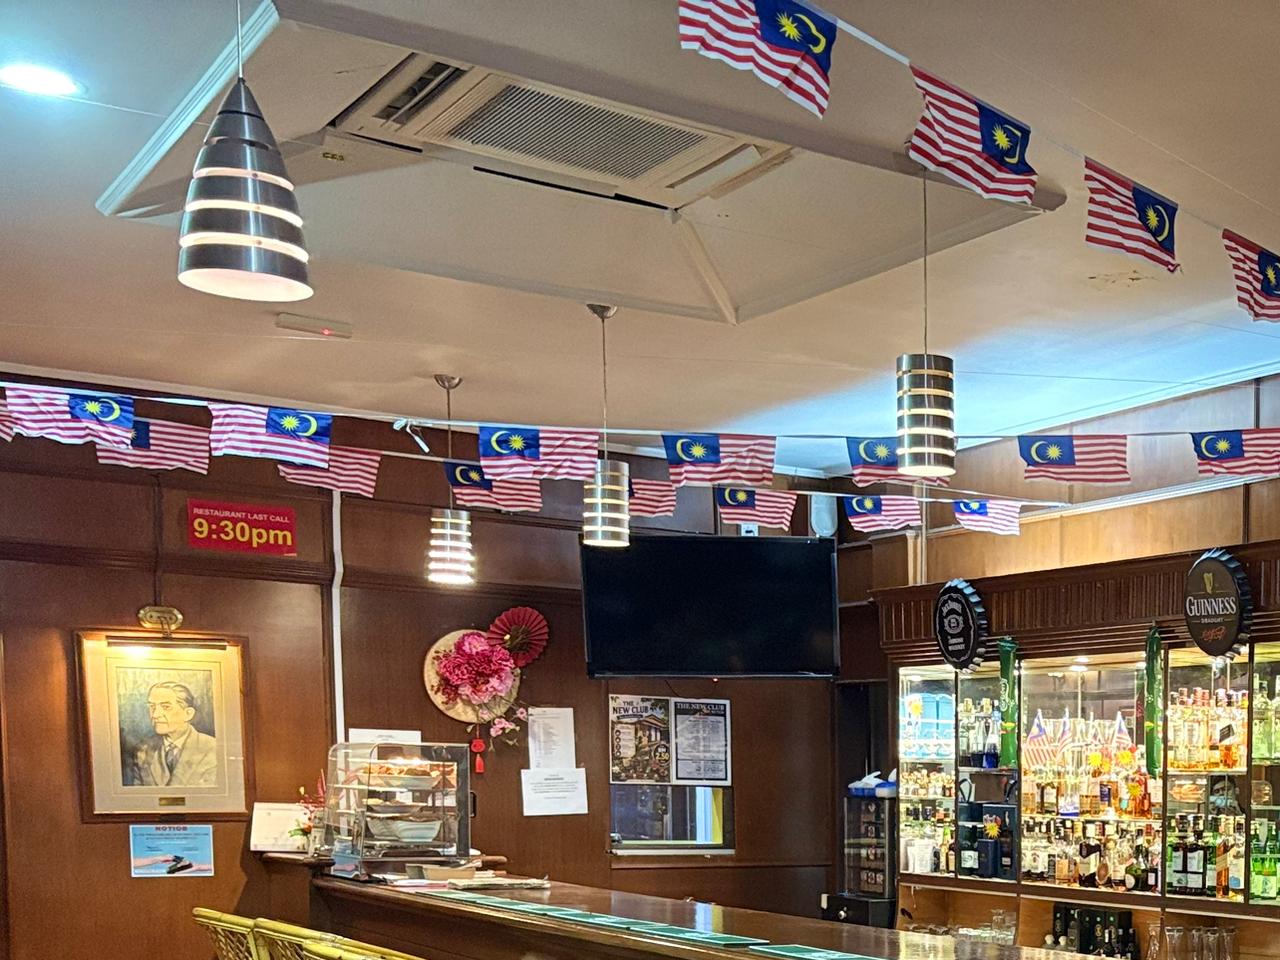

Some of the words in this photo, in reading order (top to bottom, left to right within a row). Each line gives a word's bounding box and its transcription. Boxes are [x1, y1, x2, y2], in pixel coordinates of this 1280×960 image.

[193, 508, 246, 518] RESTAURANT
[248, 513, 268, 521] LAST
[269, 514, 290, 523] CALL
[193, 518, 292, 548] 9:30pm
[1186, 596, 1236, 617] GUINNESS
[612, 706, 630, 714] NEW
[631, 705, 649, 714] CLUB
